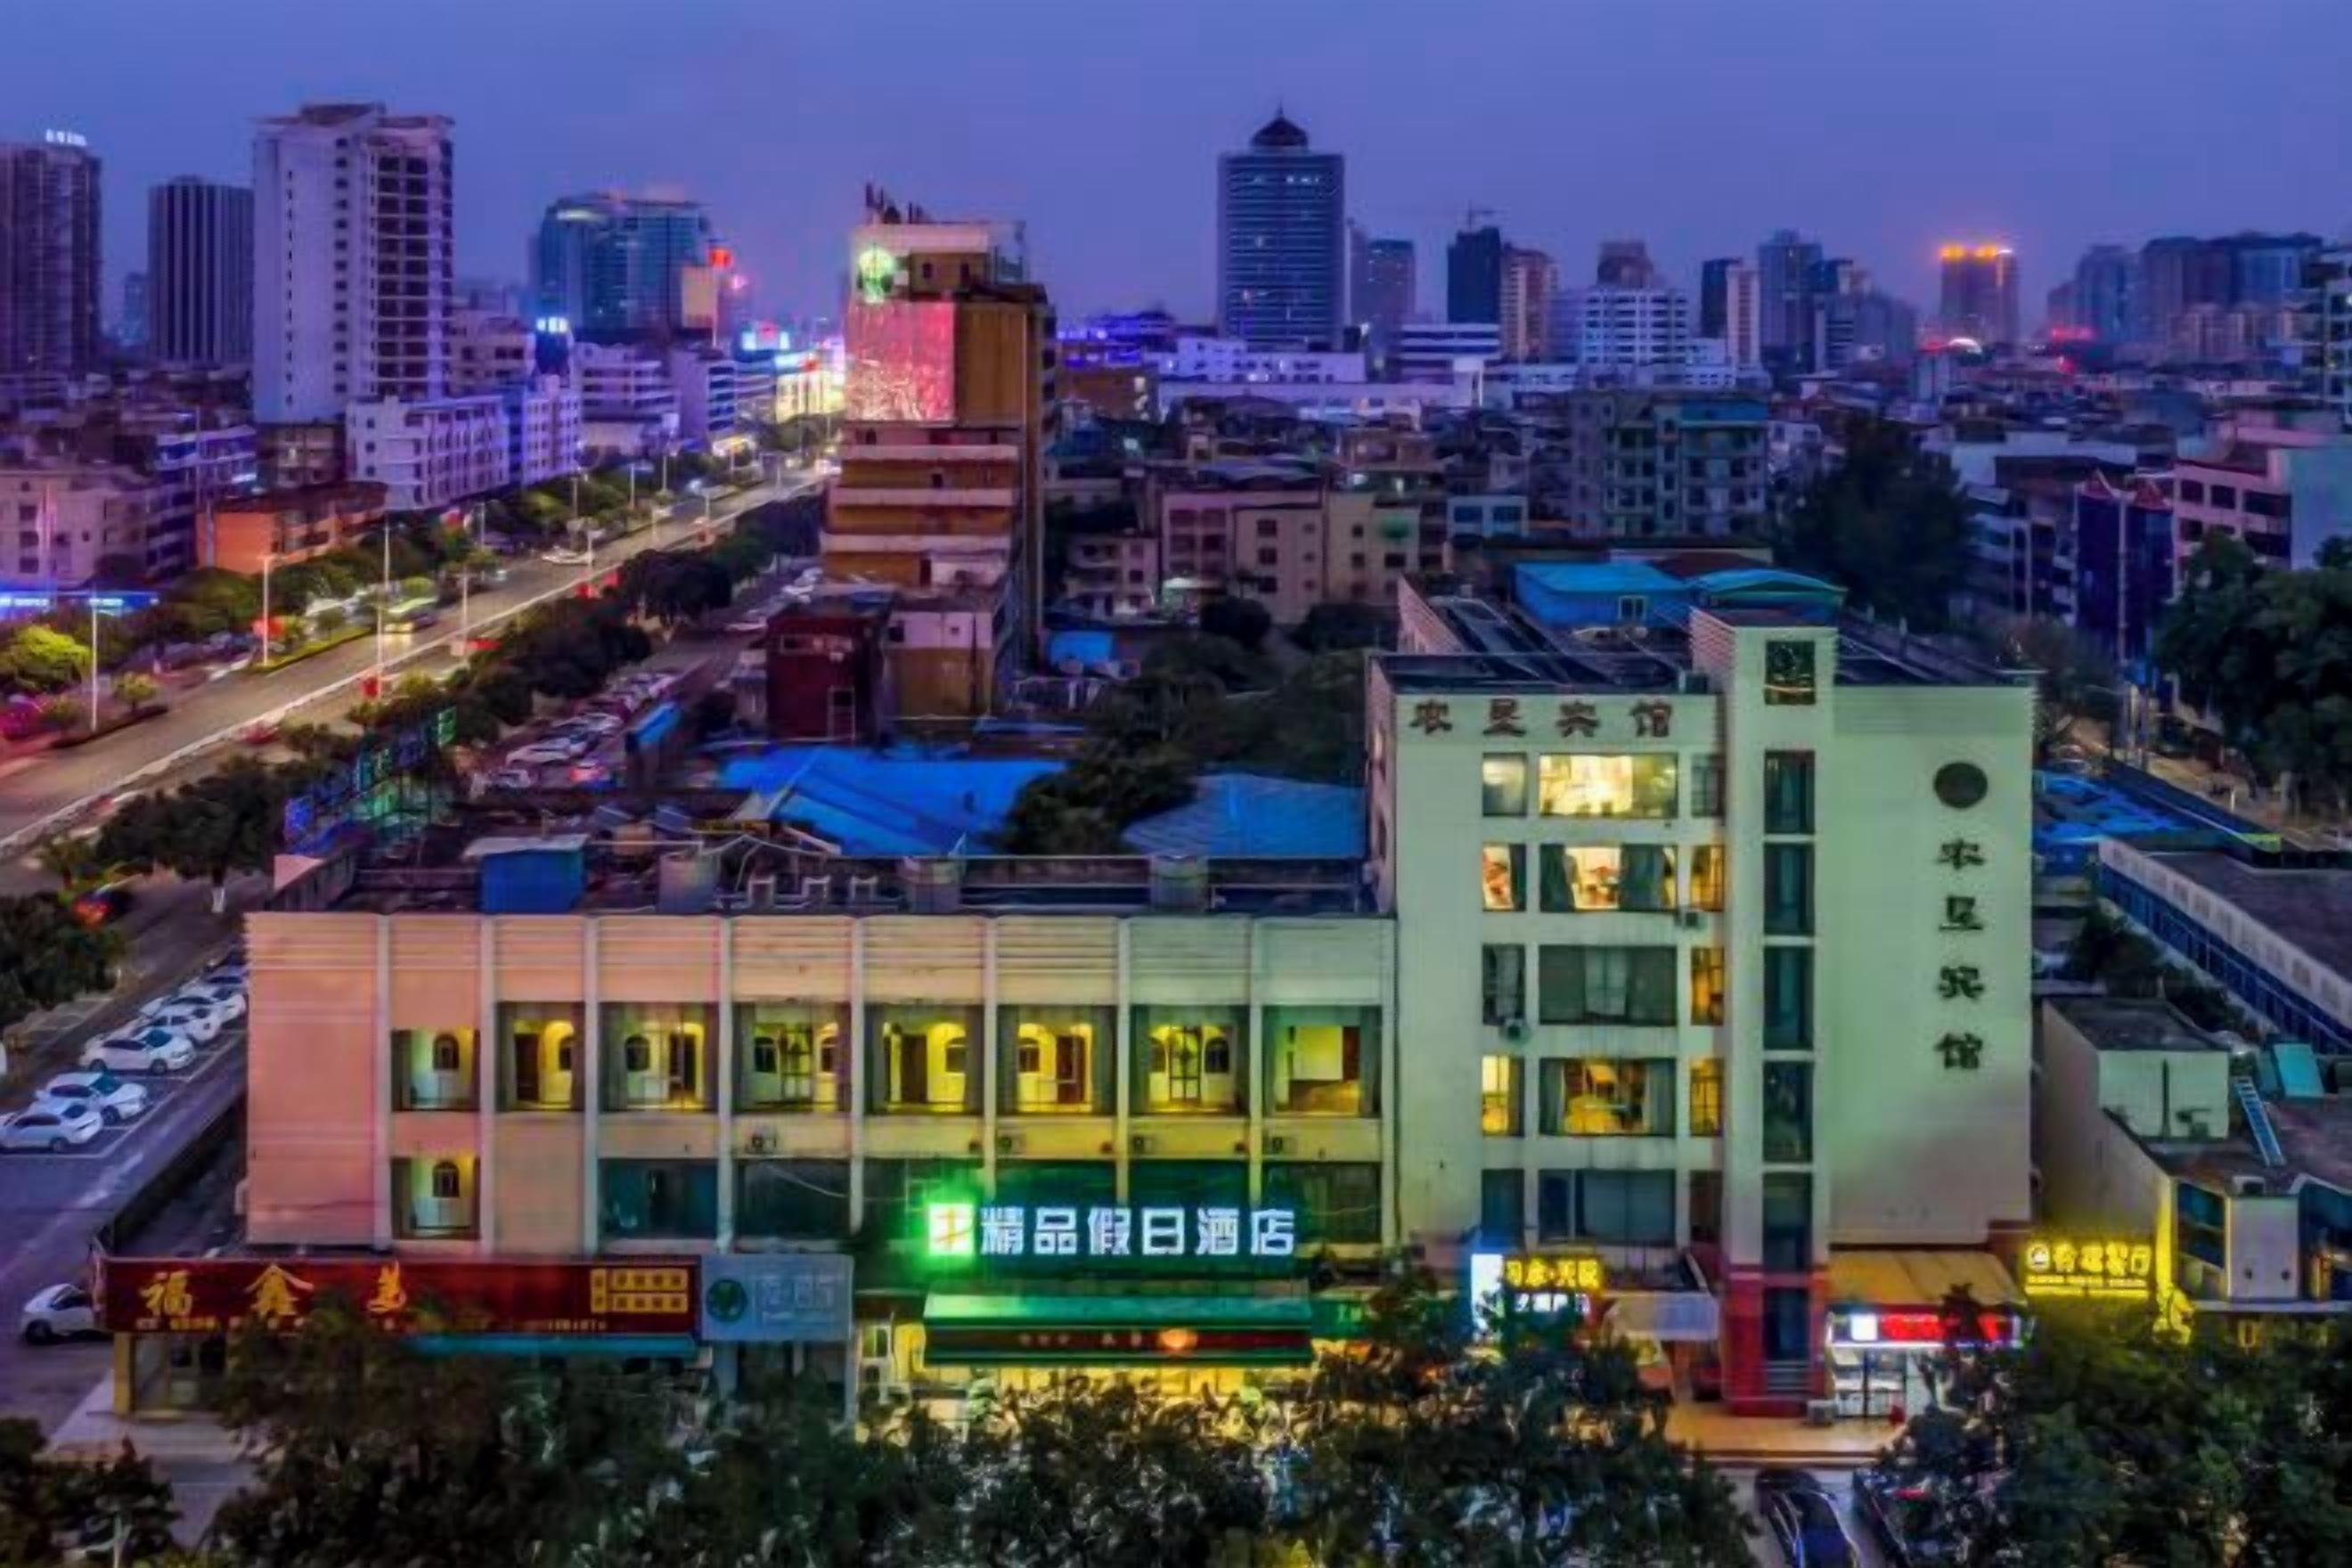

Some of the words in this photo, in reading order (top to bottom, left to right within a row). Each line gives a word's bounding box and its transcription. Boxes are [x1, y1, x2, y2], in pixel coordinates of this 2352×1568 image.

[1409, 698, 1673, 738] 农垦宾馆
[1935, 836, 1986, 1070] 农垦宾馆
[980, 1205, 1295, 1255] 精品假日酒店
